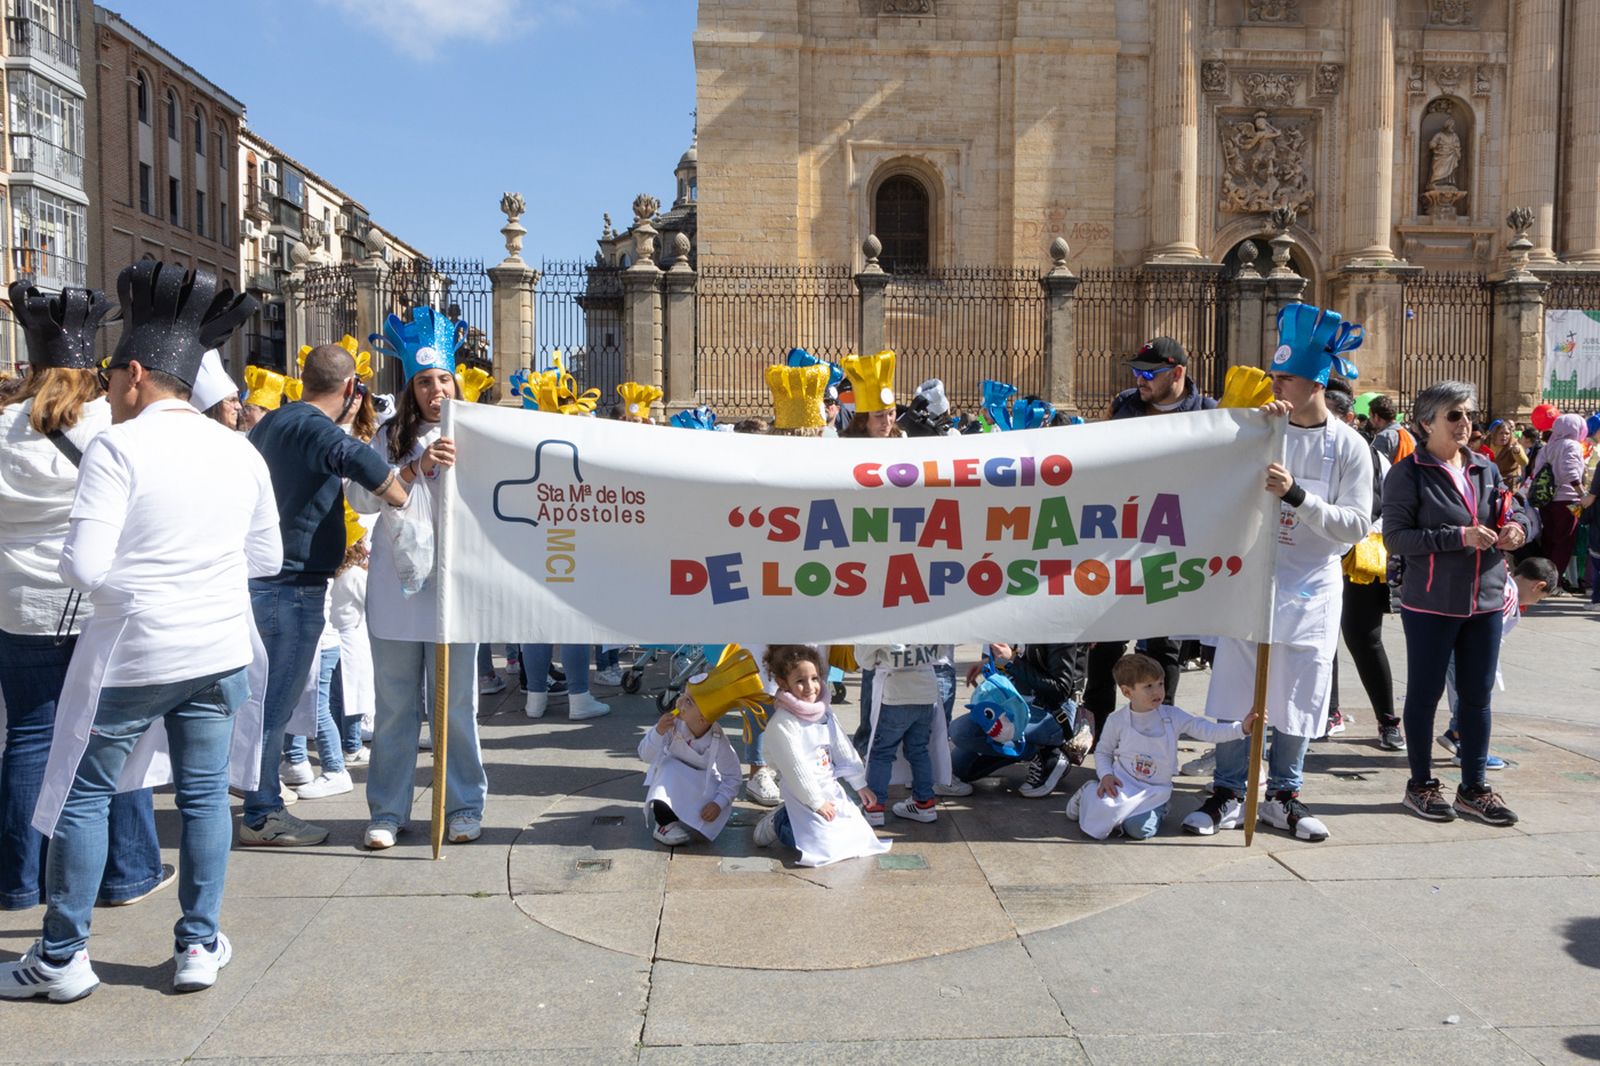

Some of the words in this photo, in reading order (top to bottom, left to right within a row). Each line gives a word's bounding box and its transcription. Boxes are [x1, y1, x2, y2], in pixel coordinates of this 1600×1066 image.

[853, 454, 1073, 488] COLEGIO
[537, 483, 565, 502] Sta
[569, 484, 592, 503] Mª
[596, 485, 617, 504] de
[621, 486, 646, 505] los
[537, 503, 646, 526] Apóstoles
[985, 493, 1186, 549] MARÍA
[545, 529, 576, 583] MCI
[670, 552, 750, 605] DE
[761, 561, 867, 597] LOS
[890, 644, 939, 667] TEAM
